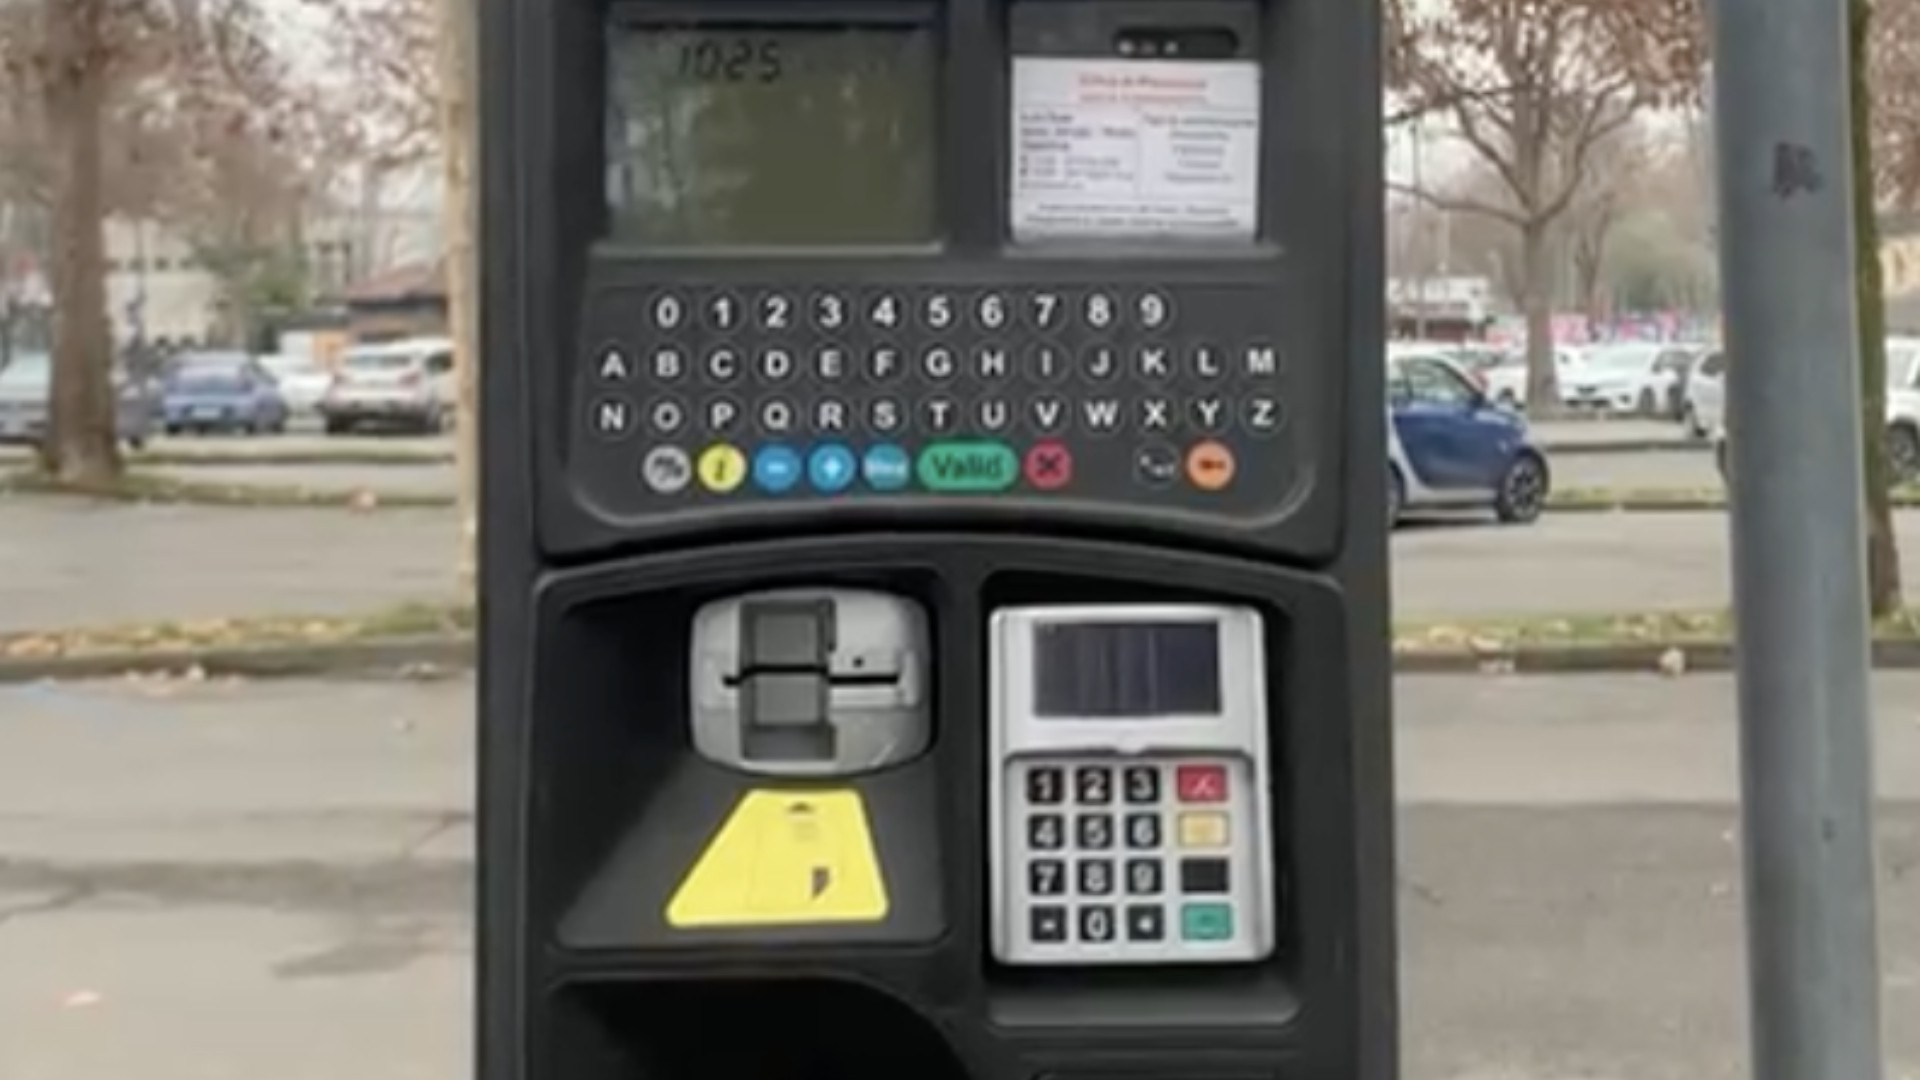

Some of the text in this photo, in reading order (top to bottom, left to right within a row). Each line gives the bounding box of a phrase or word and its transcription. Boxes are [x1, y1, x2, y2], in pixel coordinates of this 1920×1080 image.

[657, 294, 1163, 328] 0 1 2 3 4 5 6 7 8 9
[601, 352, 626, 377] A
[656, 351, 679, 377] B
[710, 350, 733, 378] C
[765, 350, 789, 377] D
[820, 350, 839, 377] E
[875, 350, 894, 376] F
[926, 349, 952, 376] G
[981, 351, 1005, 375] H
[1091, 350, 1110, 376] J
[1143, 350, 1165, 373] K
[1198, 349, 1218, 375] L
[1247, 349, 1274, 372] M
[601, 400, 1272, 431] N O P Q R S T U V W X Y Z
[930, 454, 1002, 480] Valid
[1036, 769, 1153, 800] 1 2 3
[1035, 817, 1154, 847] 4 5 6
[1036, 862, 1154, 893] 7 8 9
[1087, 909, 1107, 938] 0
